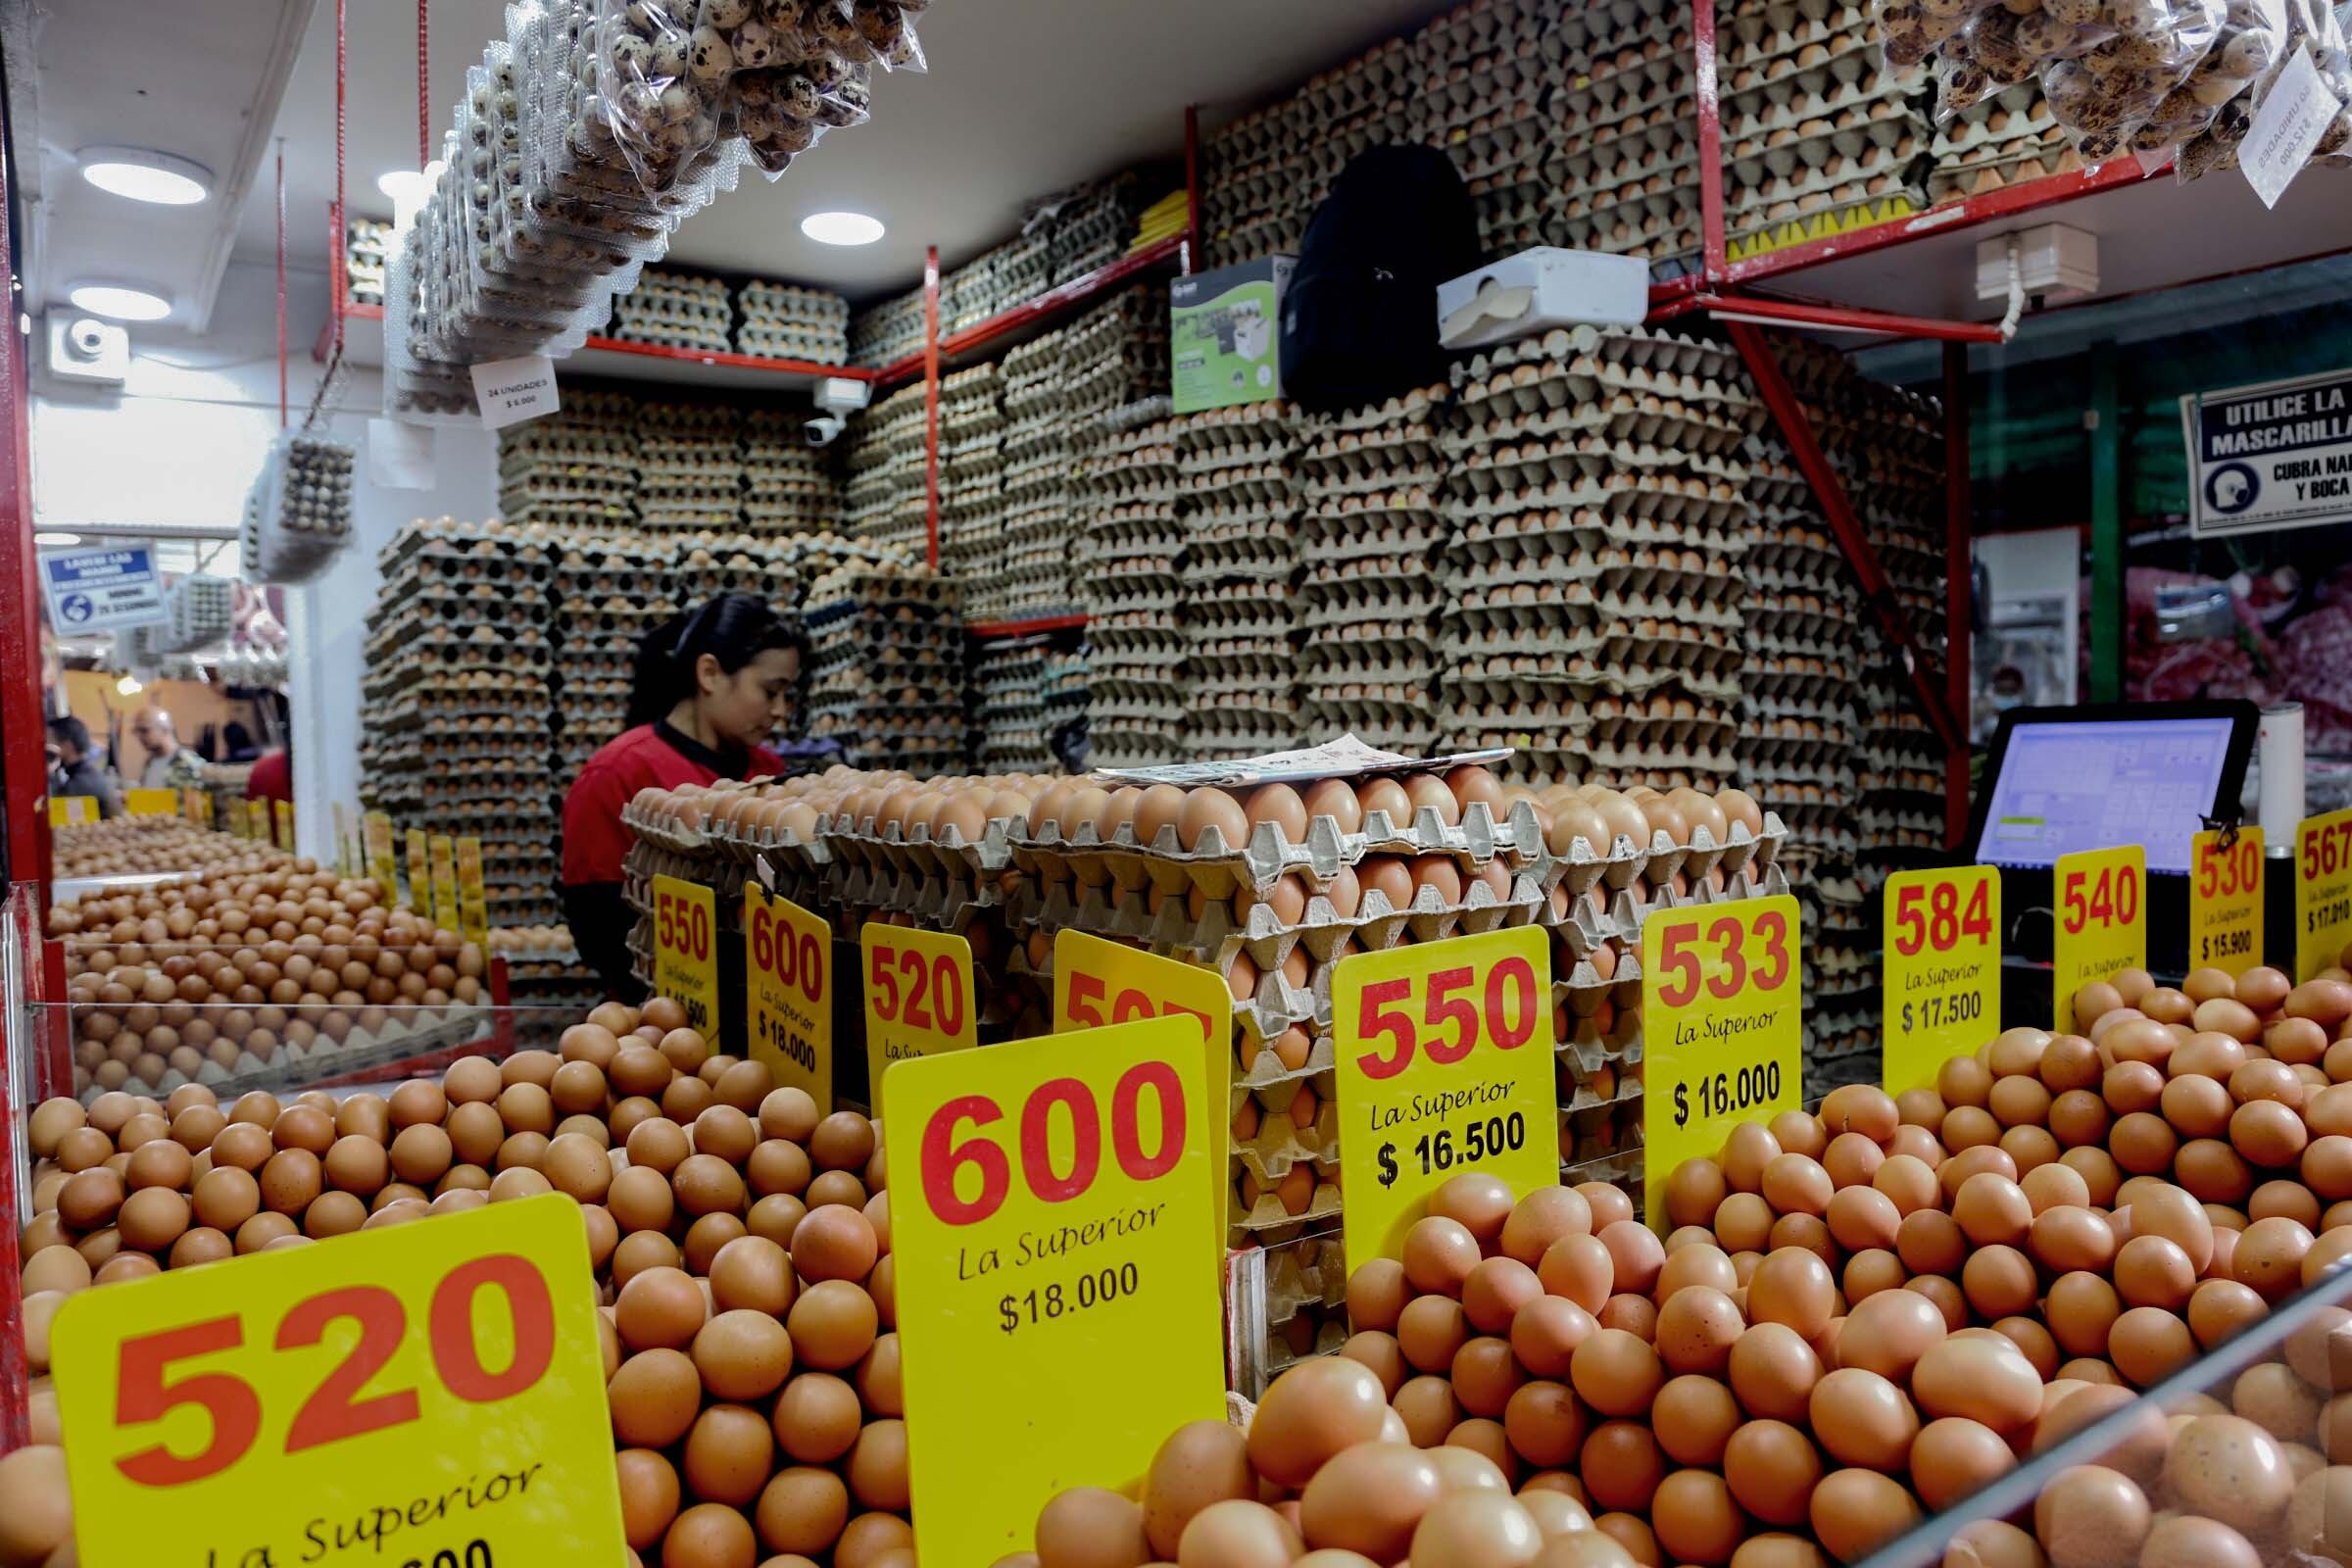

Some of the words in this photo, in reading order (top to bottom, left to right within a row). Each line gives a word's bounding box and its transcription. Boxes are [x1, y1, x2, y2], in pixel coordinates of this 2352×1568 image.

[501, 379, 547, 394] UNIDADES
[2226, 394, 2307, 426] UTILICE
[2315, 388, 2345, 412] LA
[2274, 459, 2322, 481] CUBRA
[2296, 481, 2306, 501] Y
[2311, 477, 2350, 499] BOCA
[2199, 840, 2259, 900] 530
[2304, 819, 2352, 880] 567
[660, 893, 709, 962] 550
[1895, 878, 1992, 956] 584
[2064, 865, 2137, 934] 540
[2308, 911, 2315, 933] $
[753, 906, 822, 1004] 600
[1658, 910, 1789, 1008] 533
[2202, 936, 2209, 961] $
[2214, 929, 2252, 957] 15.900
[760, 982, 772, 1004] La
[774, 992, 815, 1032] Superior
[871, 945, 963, 1036] 520
[1905, 971, 1923, 991] La
[1927, 963, 1983, 990] Superior
[759, 1010, 766, 1039] $
[770, 1018, 815, 1073] 18.000
[1356, 956, 1538, 1080] 550
[1675, 1022, 1698, 1046] La
[1703, 1010, 1778, 1045] Superior
[1902, 1001, 1913, 1035] $
[1920, 991, 1982, 1029] 17.500
[886, 1037, 901, 1059] La
[1371, 1104, 1406, 1131] La
[1410, 1081, 1515, 1121] Superior
[1674, 1080, 1689, 1130] $
[1698, 1060, 1781, 1118] 16.000
[920, 1060, 1187, 1226] 600
[1378, 1142, 1398, 1190] $
[1415, 1111, 1525, 1176] 16.500
[958, 1248, 1000, 1281] La
[1015, 1201, 1165, 1267] Superior
[1000, 1261, 1139, 1336] $18.000
[113, 1252, 556, 1488] 520
[301, 1463, 541, 1562] Superior
